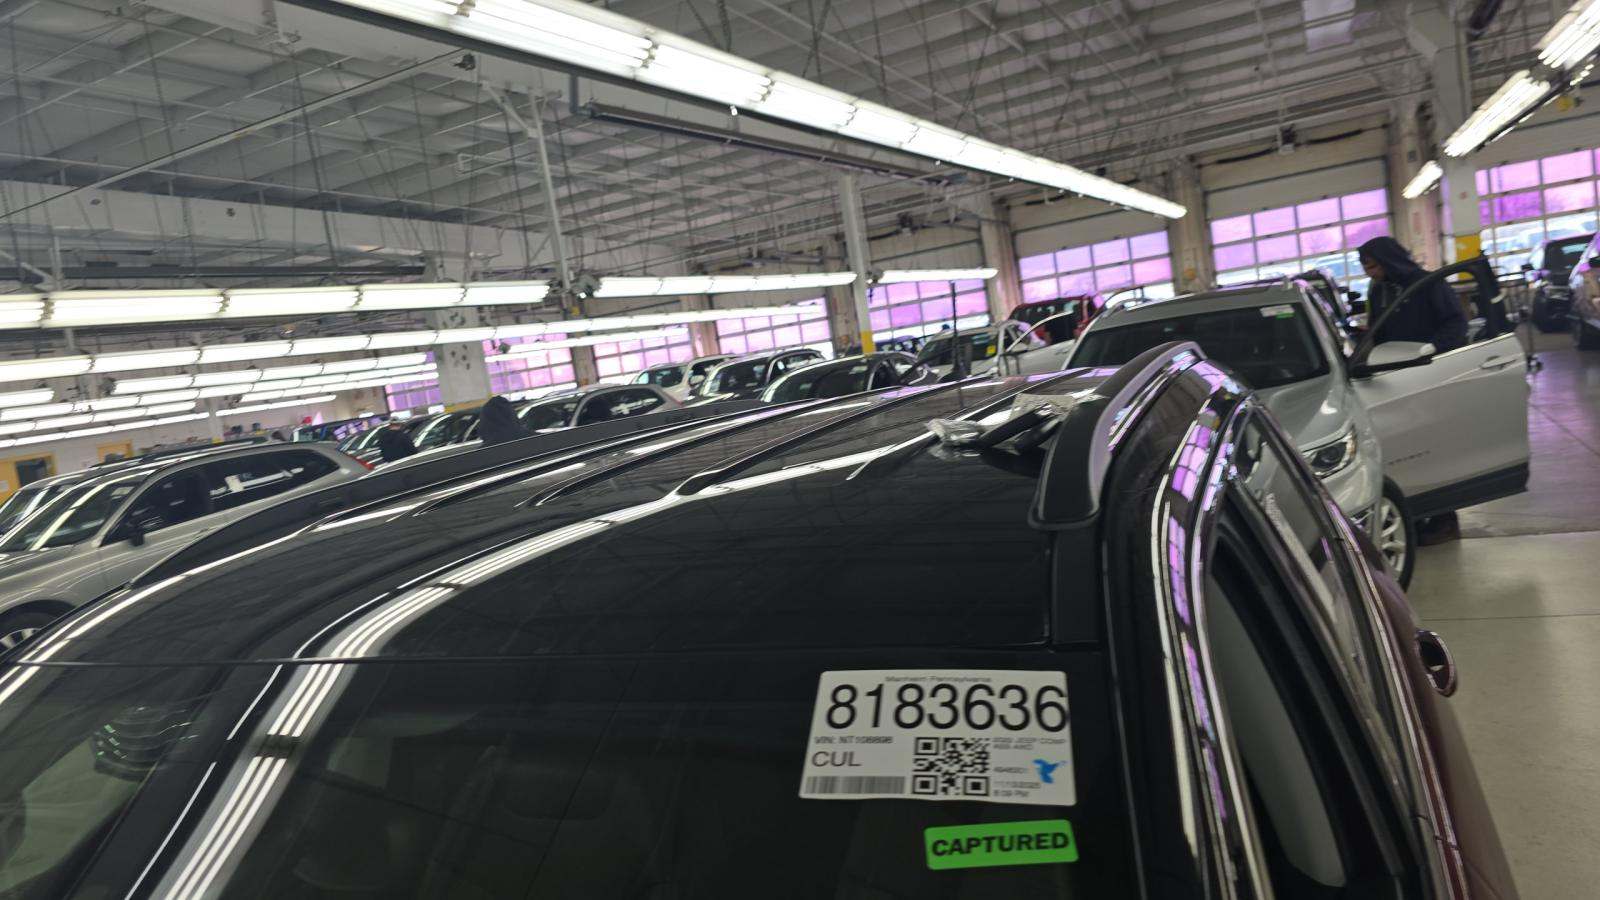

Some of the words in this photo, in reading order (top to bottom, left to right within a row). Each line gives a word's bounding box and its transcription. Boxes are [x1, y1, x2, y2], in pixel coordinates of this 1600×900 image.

[826, 683, 1069, 732] 8183636
[811, 751, 862, 767] CUL
[931, 832, 1070, 856] CAPTURED
